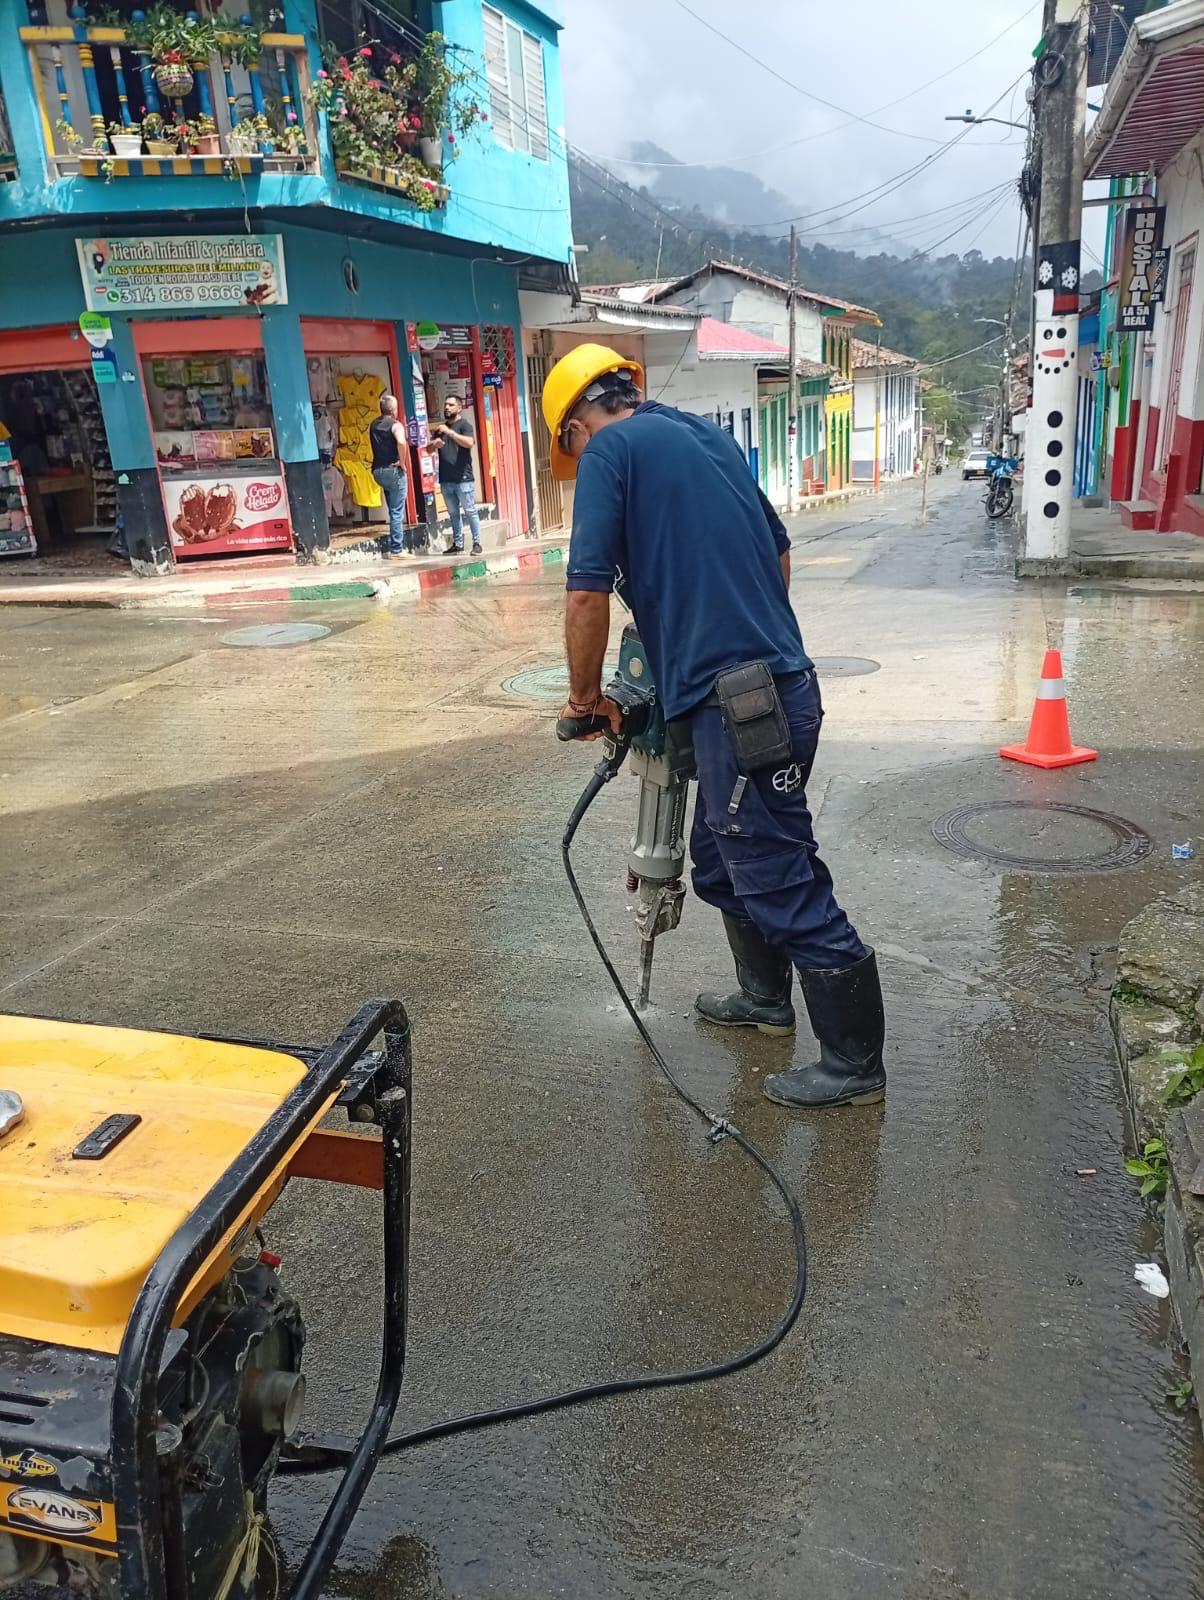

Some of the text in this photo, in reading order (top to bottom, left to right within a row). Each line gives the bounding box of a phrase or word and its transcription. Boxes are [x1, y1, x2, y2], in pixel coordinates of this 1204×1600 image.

[110, 238, 265, 261] Tienda Infantil & pañalera
[1128, 212, 1156, 306] HOSTAL
[108, 261, 260, 275] LAS TRAVESURAS DE EMILIANO
[120, 284, 243, 303] 314 866 9666
[1122, 307, 1134, 316] LA
[1123, 316, 1147, 326] REAL
[248, 486, 275, 498] Crem
[246, 494, 279, 509] Helado
[2, 1458, 51, 1471] hunder
[19, 1497, 90, 1521] EVANS
